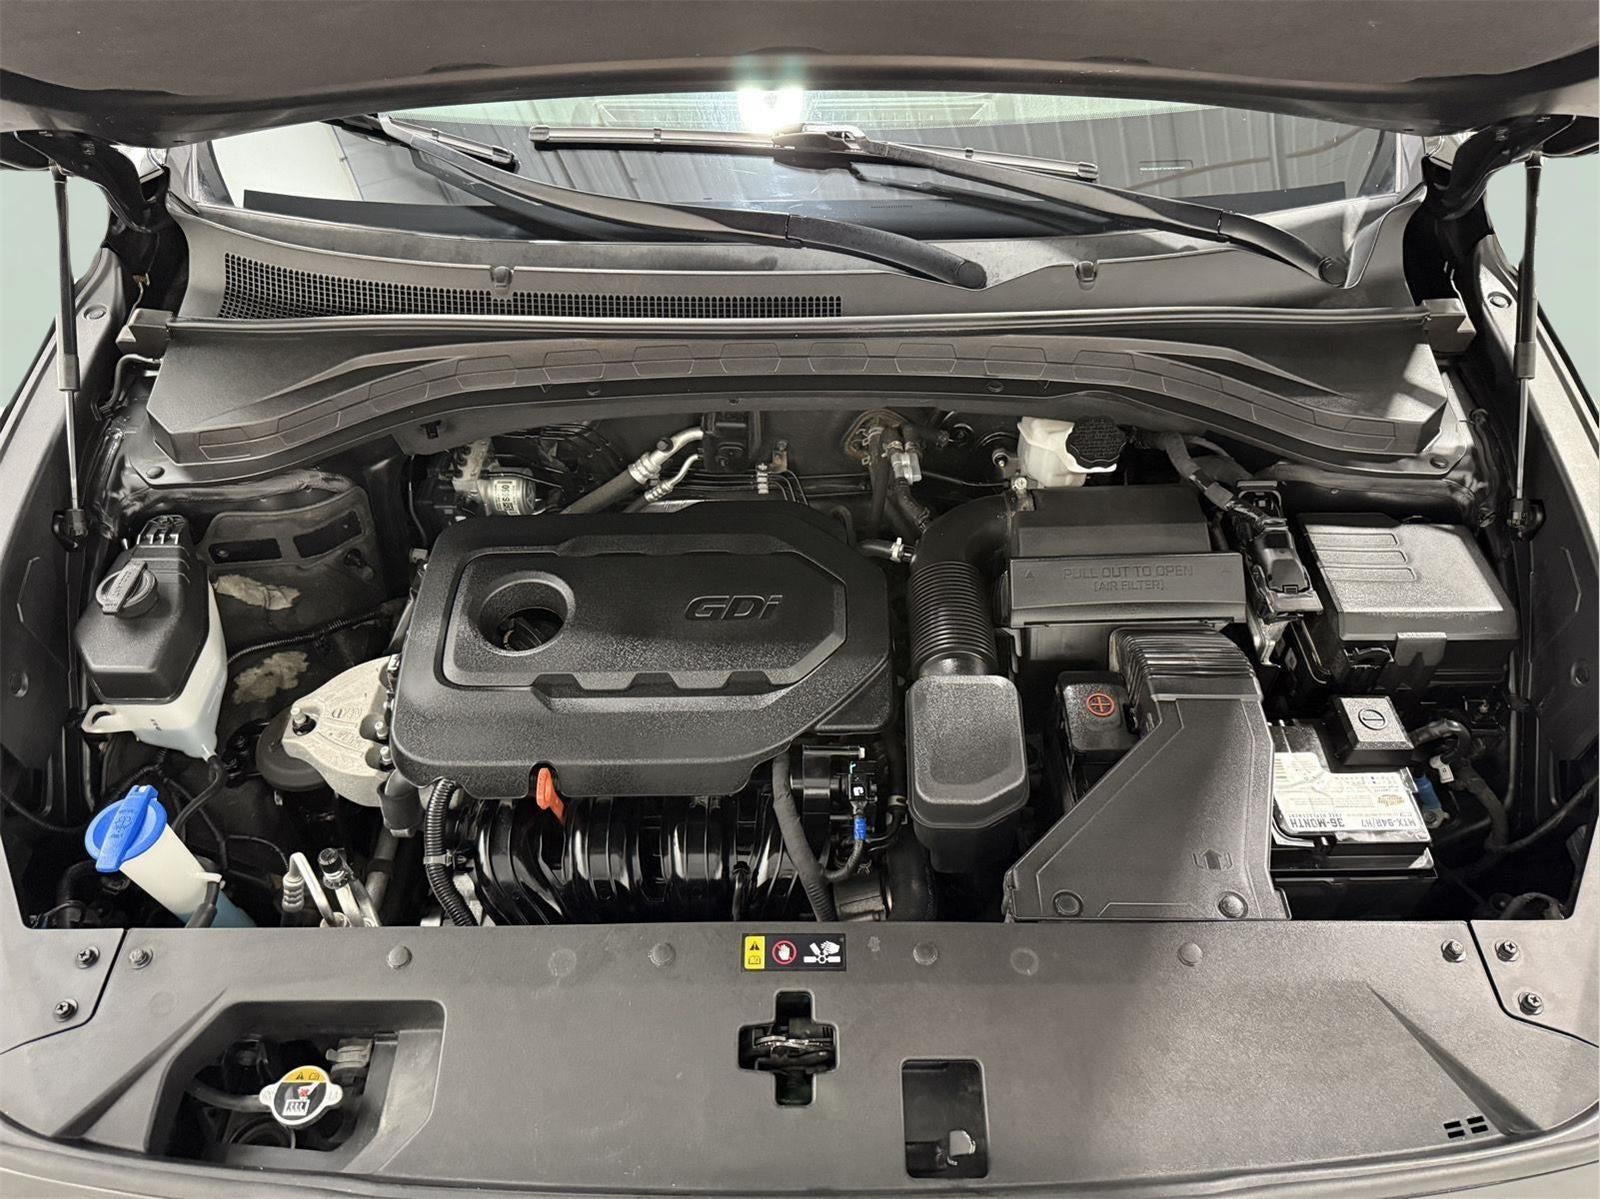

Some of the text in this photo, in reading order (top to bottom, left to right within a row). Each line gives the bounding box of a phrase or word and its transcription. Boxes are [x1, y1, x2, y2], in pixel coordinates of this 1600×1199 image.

[1063, 565, 1193, 580] PULL OUT TO OPEN
[683, 594, 783, 619] GDi
[1290, 818, 1345, 828] 36-MONTH
